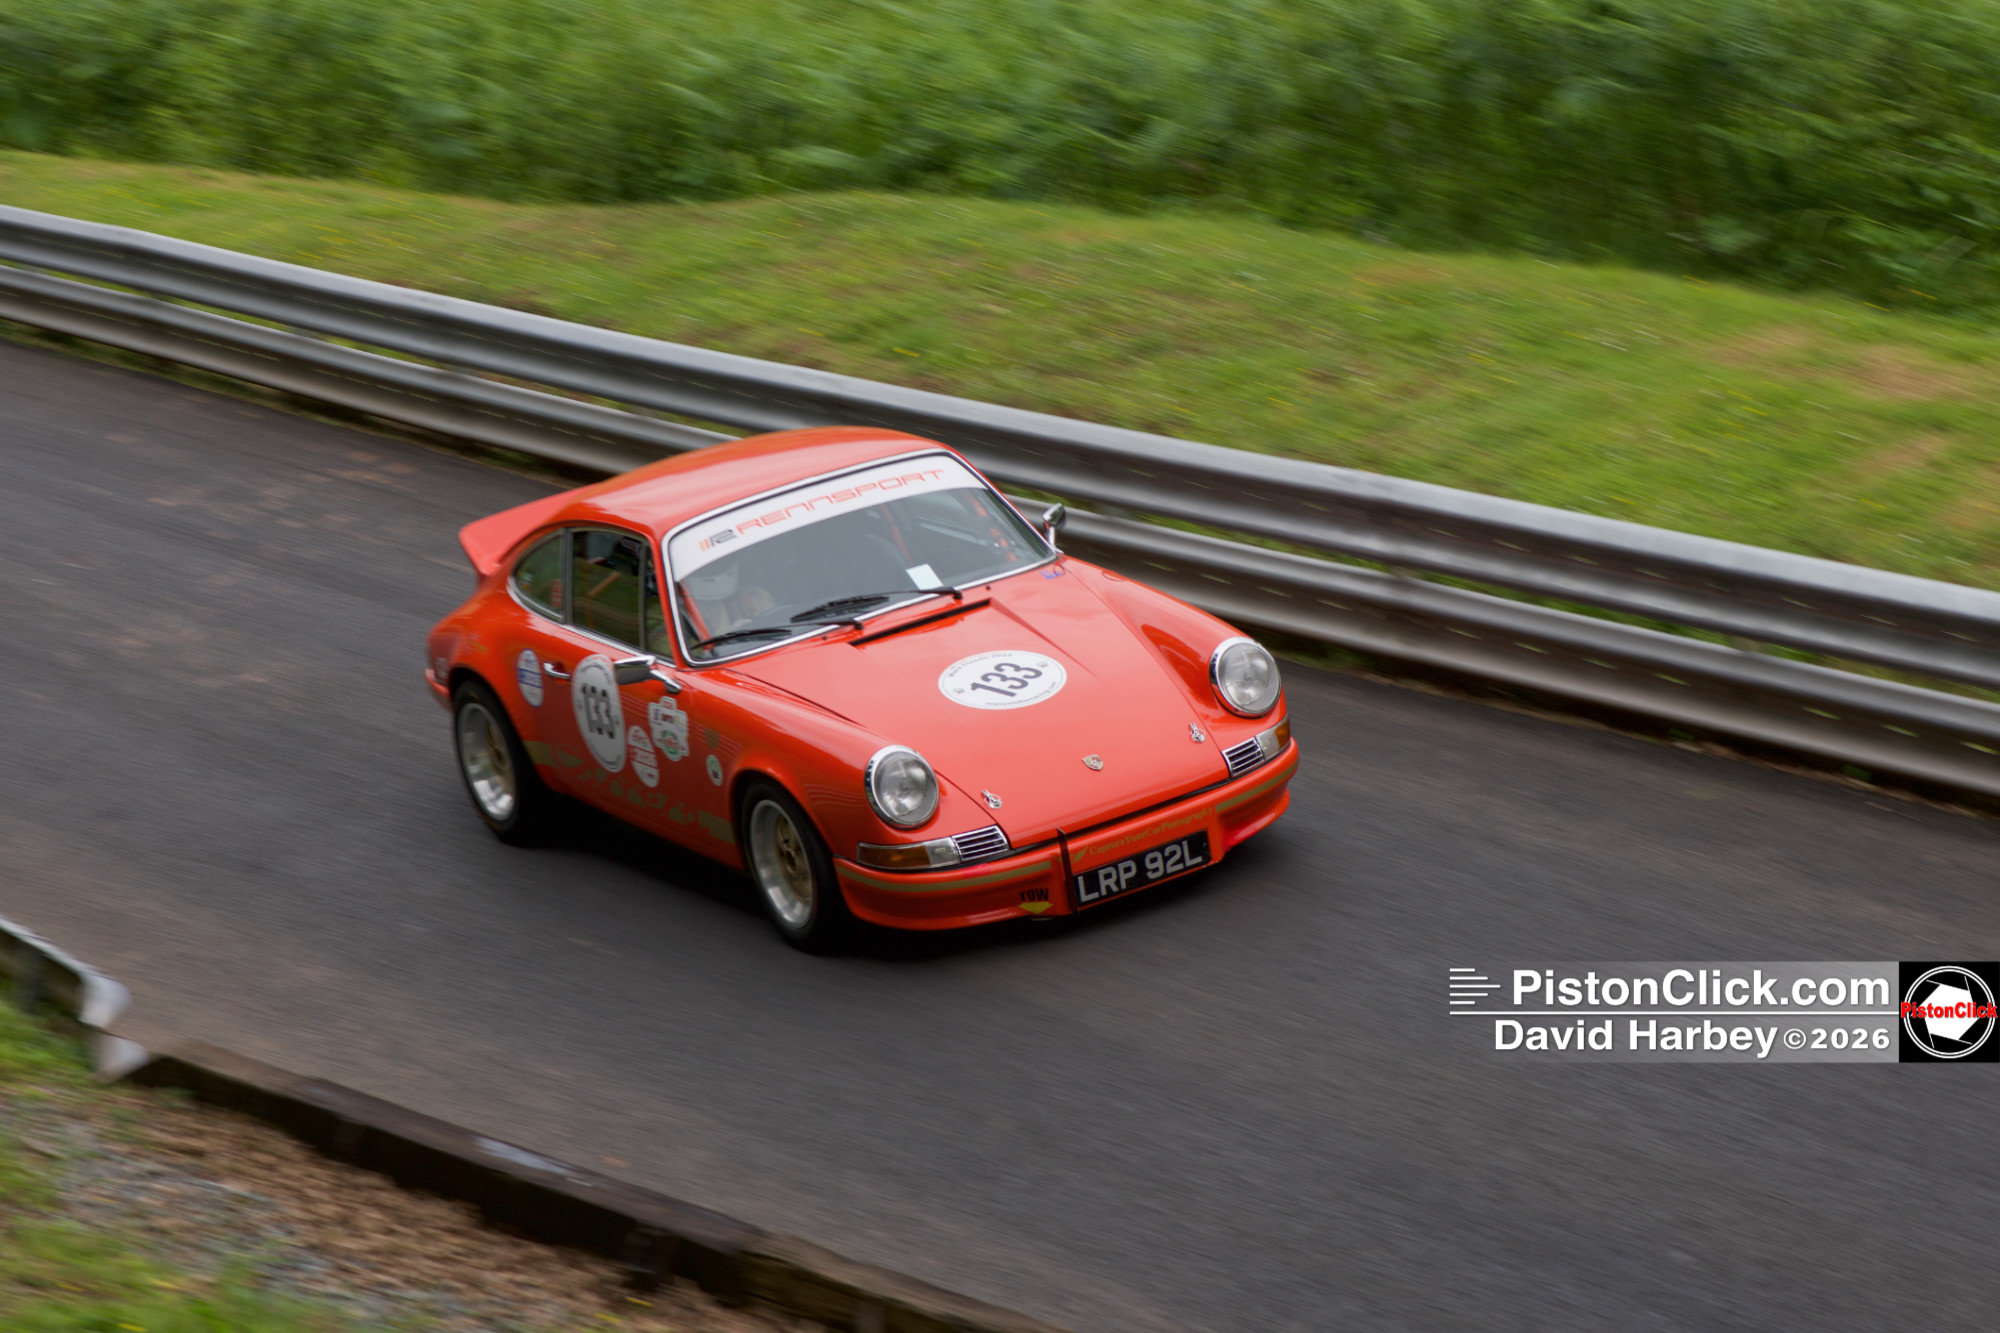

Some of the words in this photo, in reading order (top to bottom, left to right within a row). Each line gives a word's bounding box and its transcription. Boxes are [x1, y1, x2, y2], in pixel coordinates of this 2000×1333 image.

[738, 469, 945, 535] RENNSPORT
[970, 661, 1044, 698] 133
[580, 683, 616, 740] 133
[1018, 887, 1049, 903] TOW
[1077, 859, 1138, 904] LRP
[1144, 839, 1204, 880] 92L
